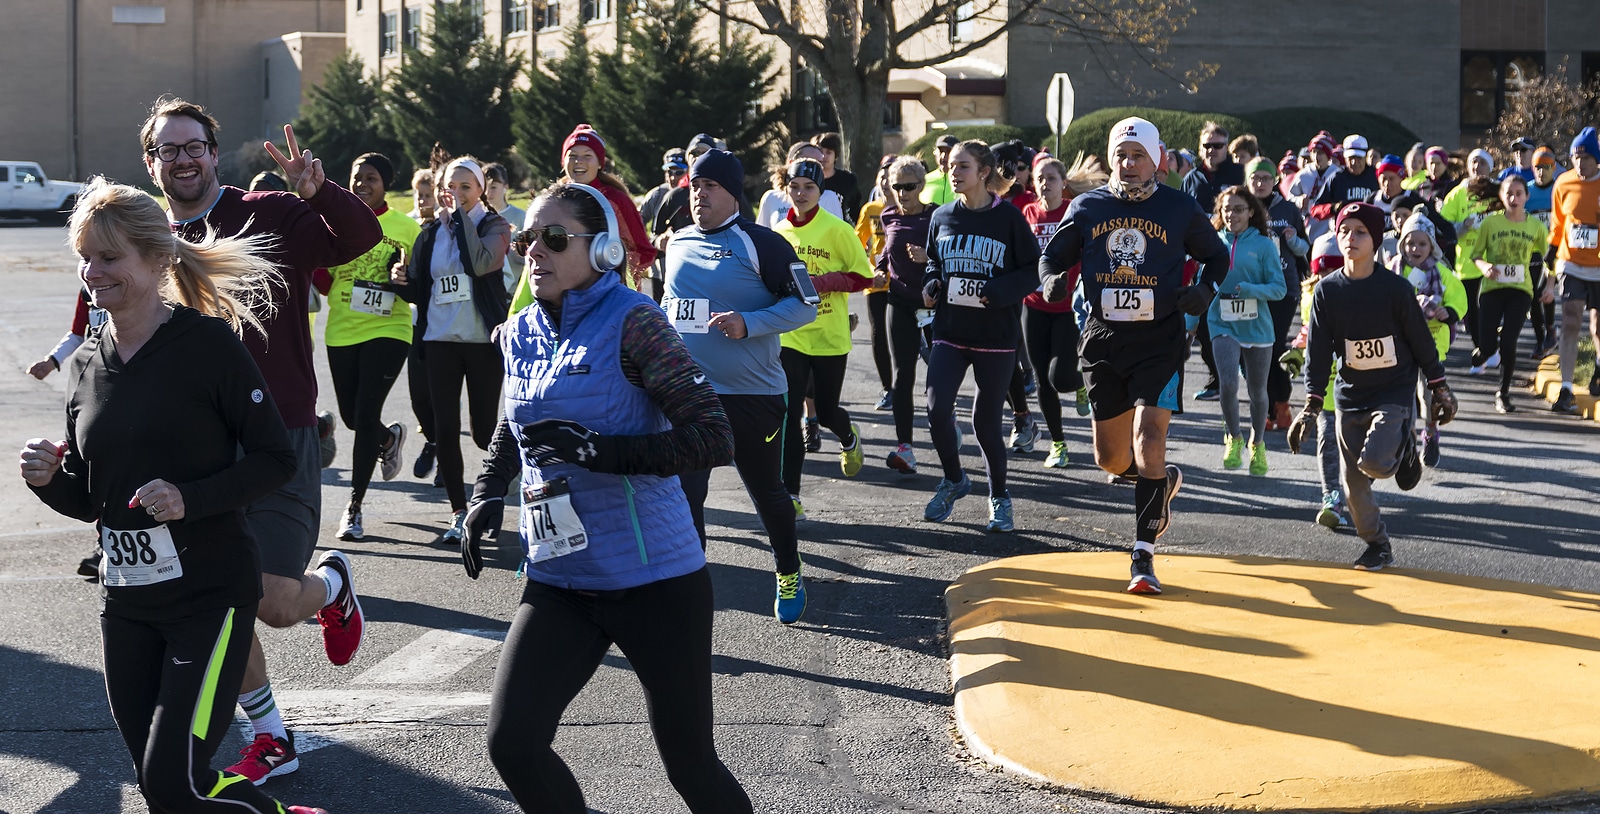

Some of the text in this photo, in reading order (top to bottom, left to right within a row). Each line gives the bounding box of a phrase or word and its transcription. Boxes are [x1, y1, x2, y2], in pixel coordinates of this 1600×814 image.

[1091, 217, 1168, 245] MASSAPEQUA
[936, 233, 1007, 269] VILLANOVA
[944, 258, 994, 278] UNIVERSITY
[1504, 265, 1516, 277] 68
[440, 275, 459, 294] 119
[958, 279, 985, 297] 366
[1095, 273, 1158, 286] WRESTLING
[363, 289, 383, 307] 214
[1113, 289, 1141, 310] 125
[1231, 300, 1245, 313] 177
[675, 299, 696, 321] 131
[1354, 339, 1385, 359] 330
[528, 503, 558, 540] 174
[108, 531, 157, 566] 398
